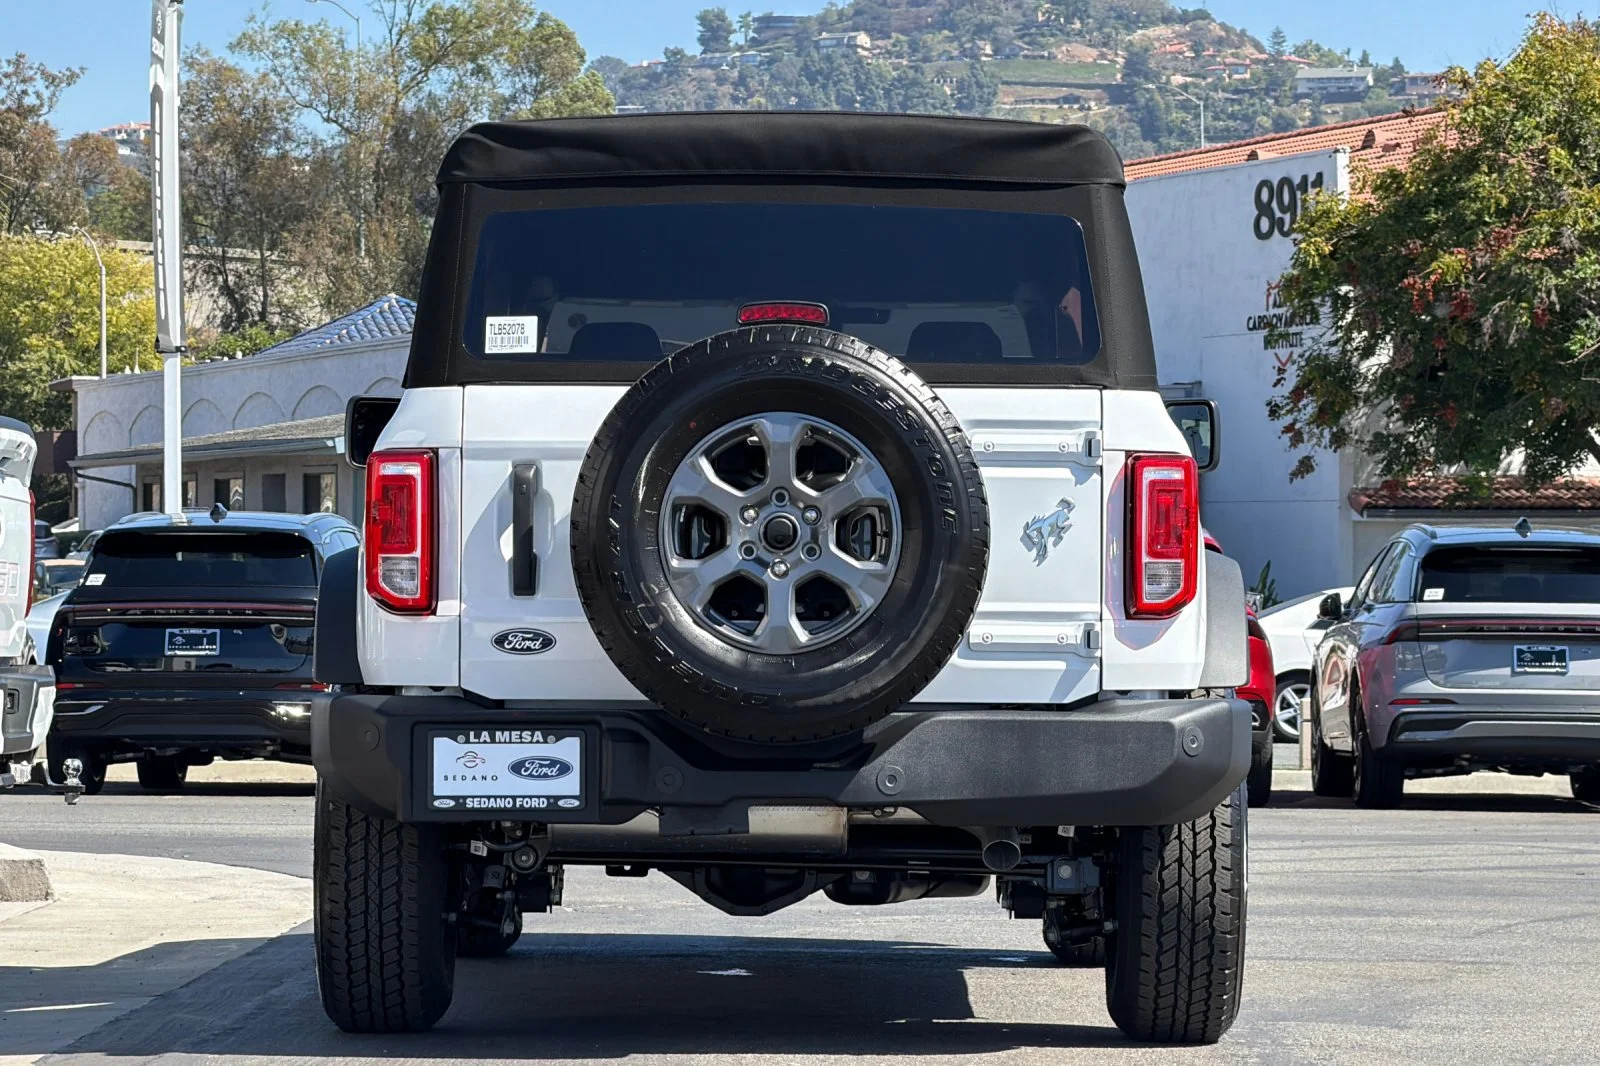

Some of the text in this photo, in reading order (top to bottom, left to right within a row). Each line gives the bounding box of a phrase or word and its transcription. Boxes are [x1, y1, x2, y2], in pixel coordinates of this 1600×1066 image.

[489, 323, 526, 335] TLB52078
[504, 632, 543, 649] Ford
[469, 731, 544, 743] LA MESA
[521, 759, 561, 776] Ford
[465, 797, 548, 809] SEDANO FORD
